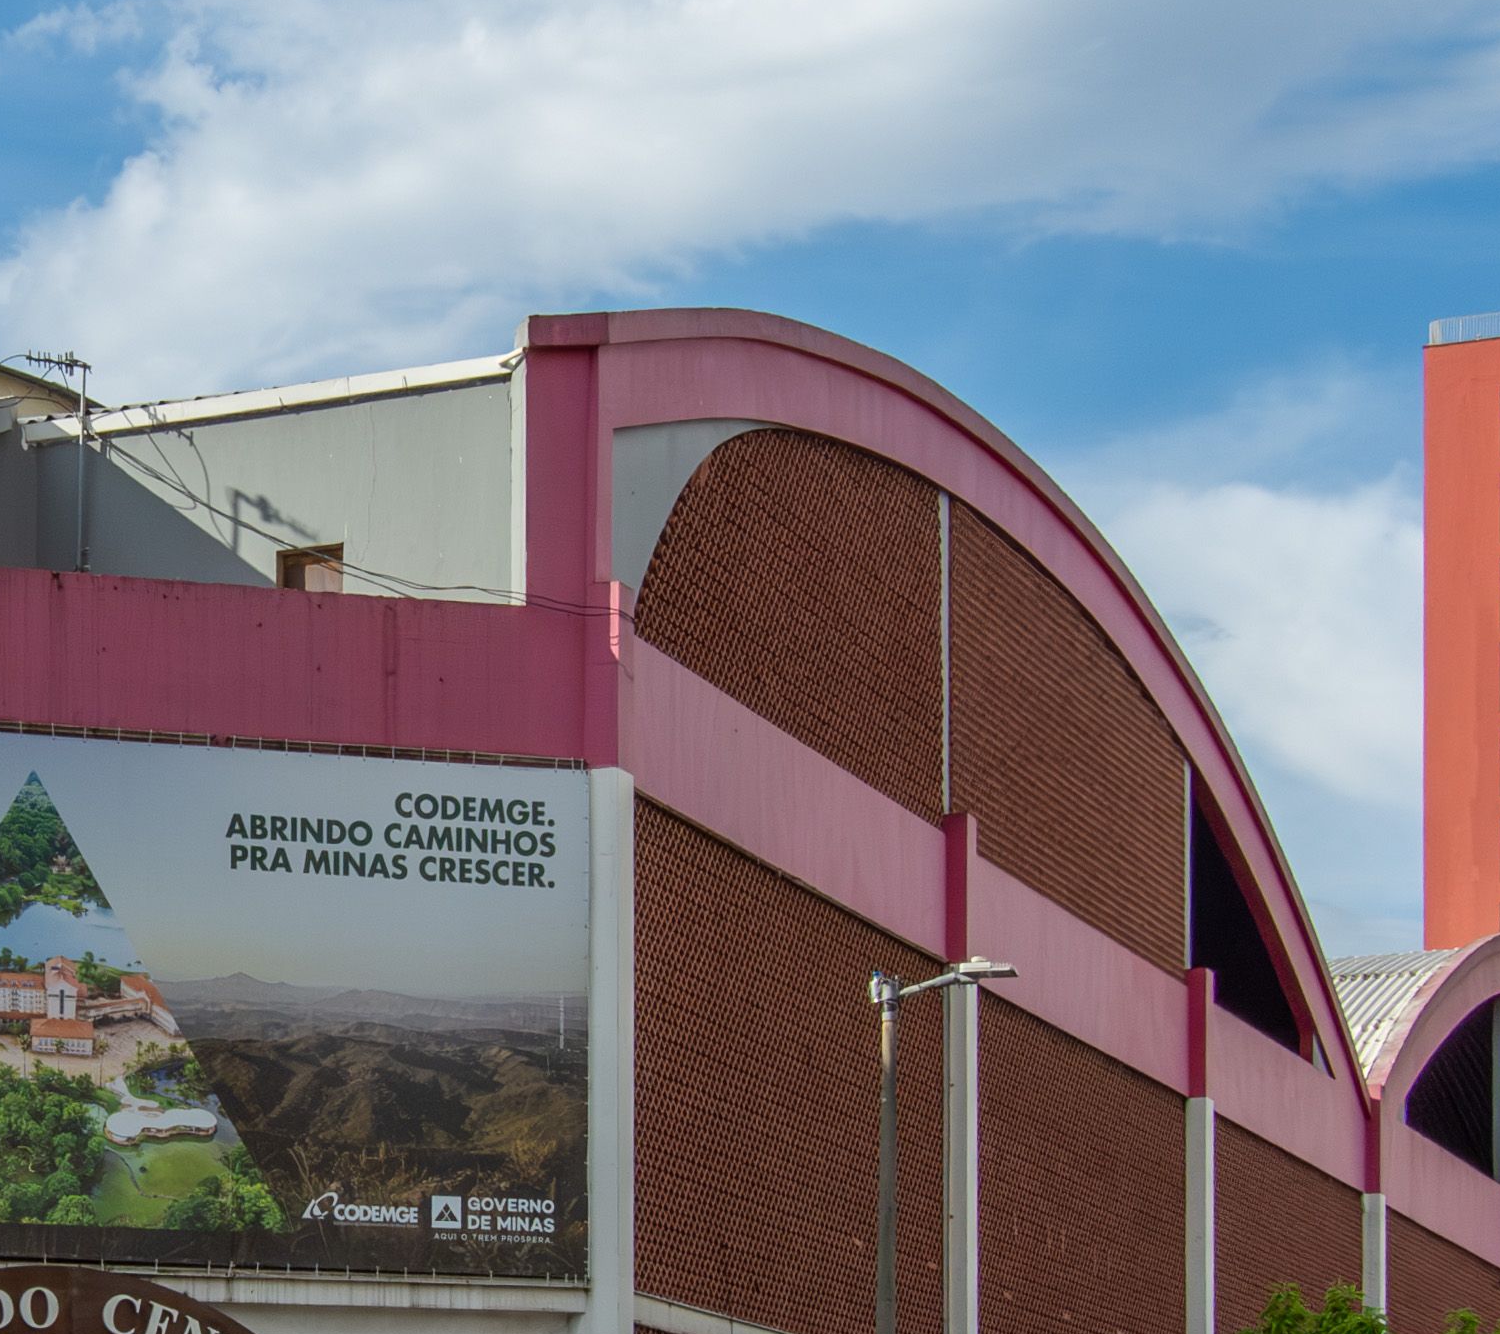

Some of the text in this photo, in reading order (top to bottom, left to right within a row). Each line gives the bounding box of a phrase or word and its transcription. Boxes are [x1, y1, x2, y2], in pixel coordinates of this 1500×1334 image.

[395, 792, 555, 827] CODEMGE.
[226, 813, 556, 858] ABRINDO CAMINHOS
[230, 845, 555, 888] PRA MINAS CRESCER.
[334, 1203, 418, 1224] CODEMGE
[467, 1197, 555, 1215] GOVERNO
[467, 1213, 555, 1233] DE MINAS
[434, 1232, 457, 1241] AQUI
[461, 1233, 468, 1241] O
